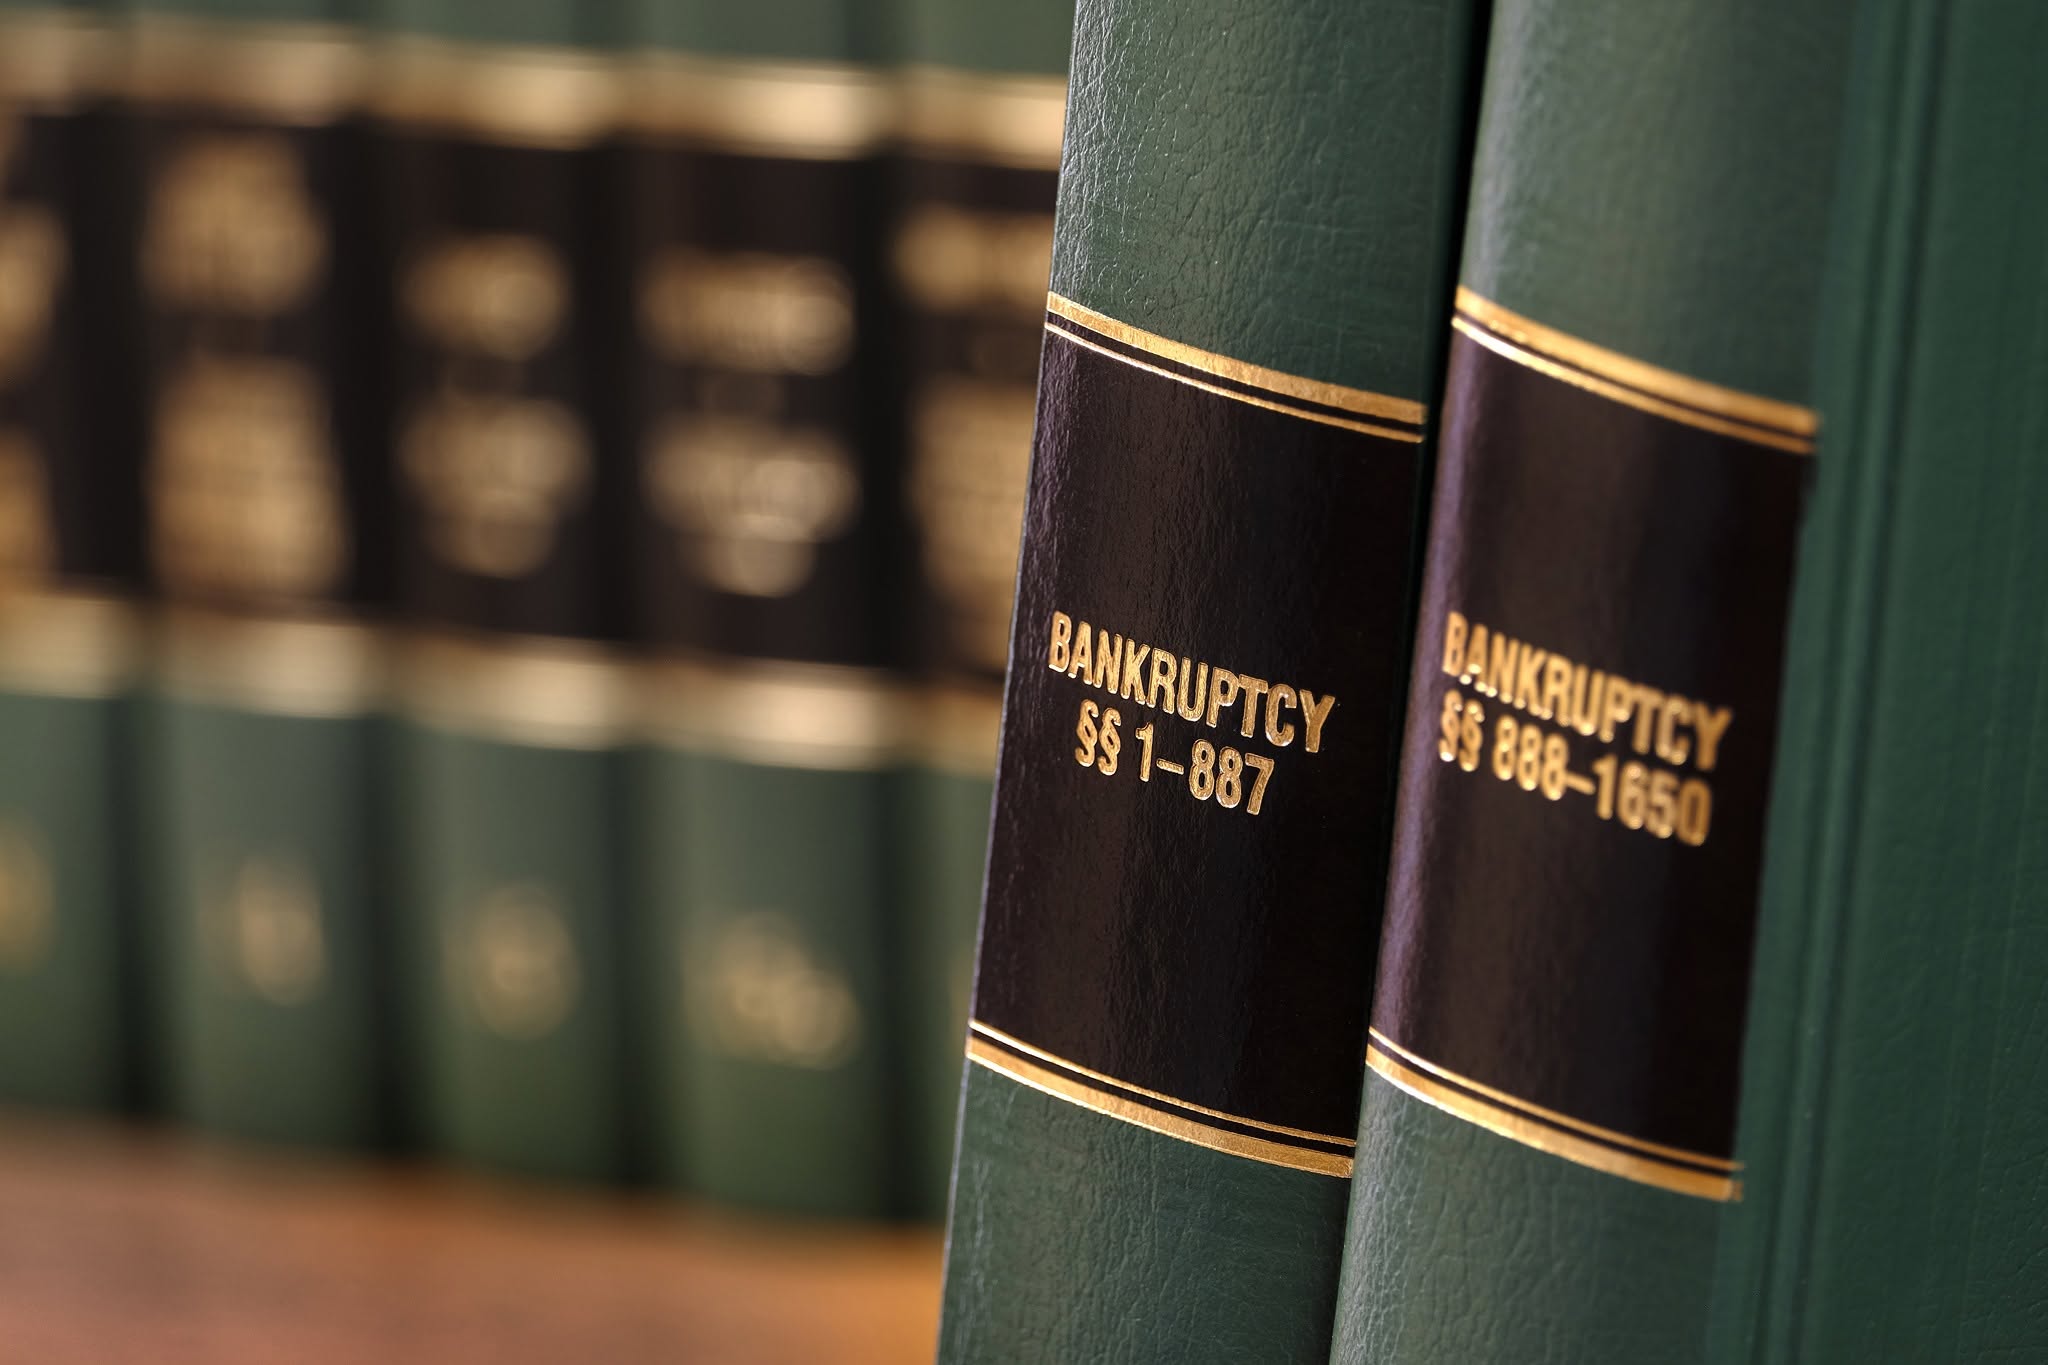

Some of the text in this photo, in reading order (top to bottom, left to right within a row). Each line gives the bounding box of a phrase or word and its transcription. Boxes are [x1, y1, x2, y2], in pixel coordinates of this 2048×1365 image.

[1049, 611, 1336, 753] BANKRUPTCY
[1075, 698, 1121, 776] §§
[1439, 689, 1485, 772] §§
[1442, 611, 1733, 771] BANKRUPTCY
